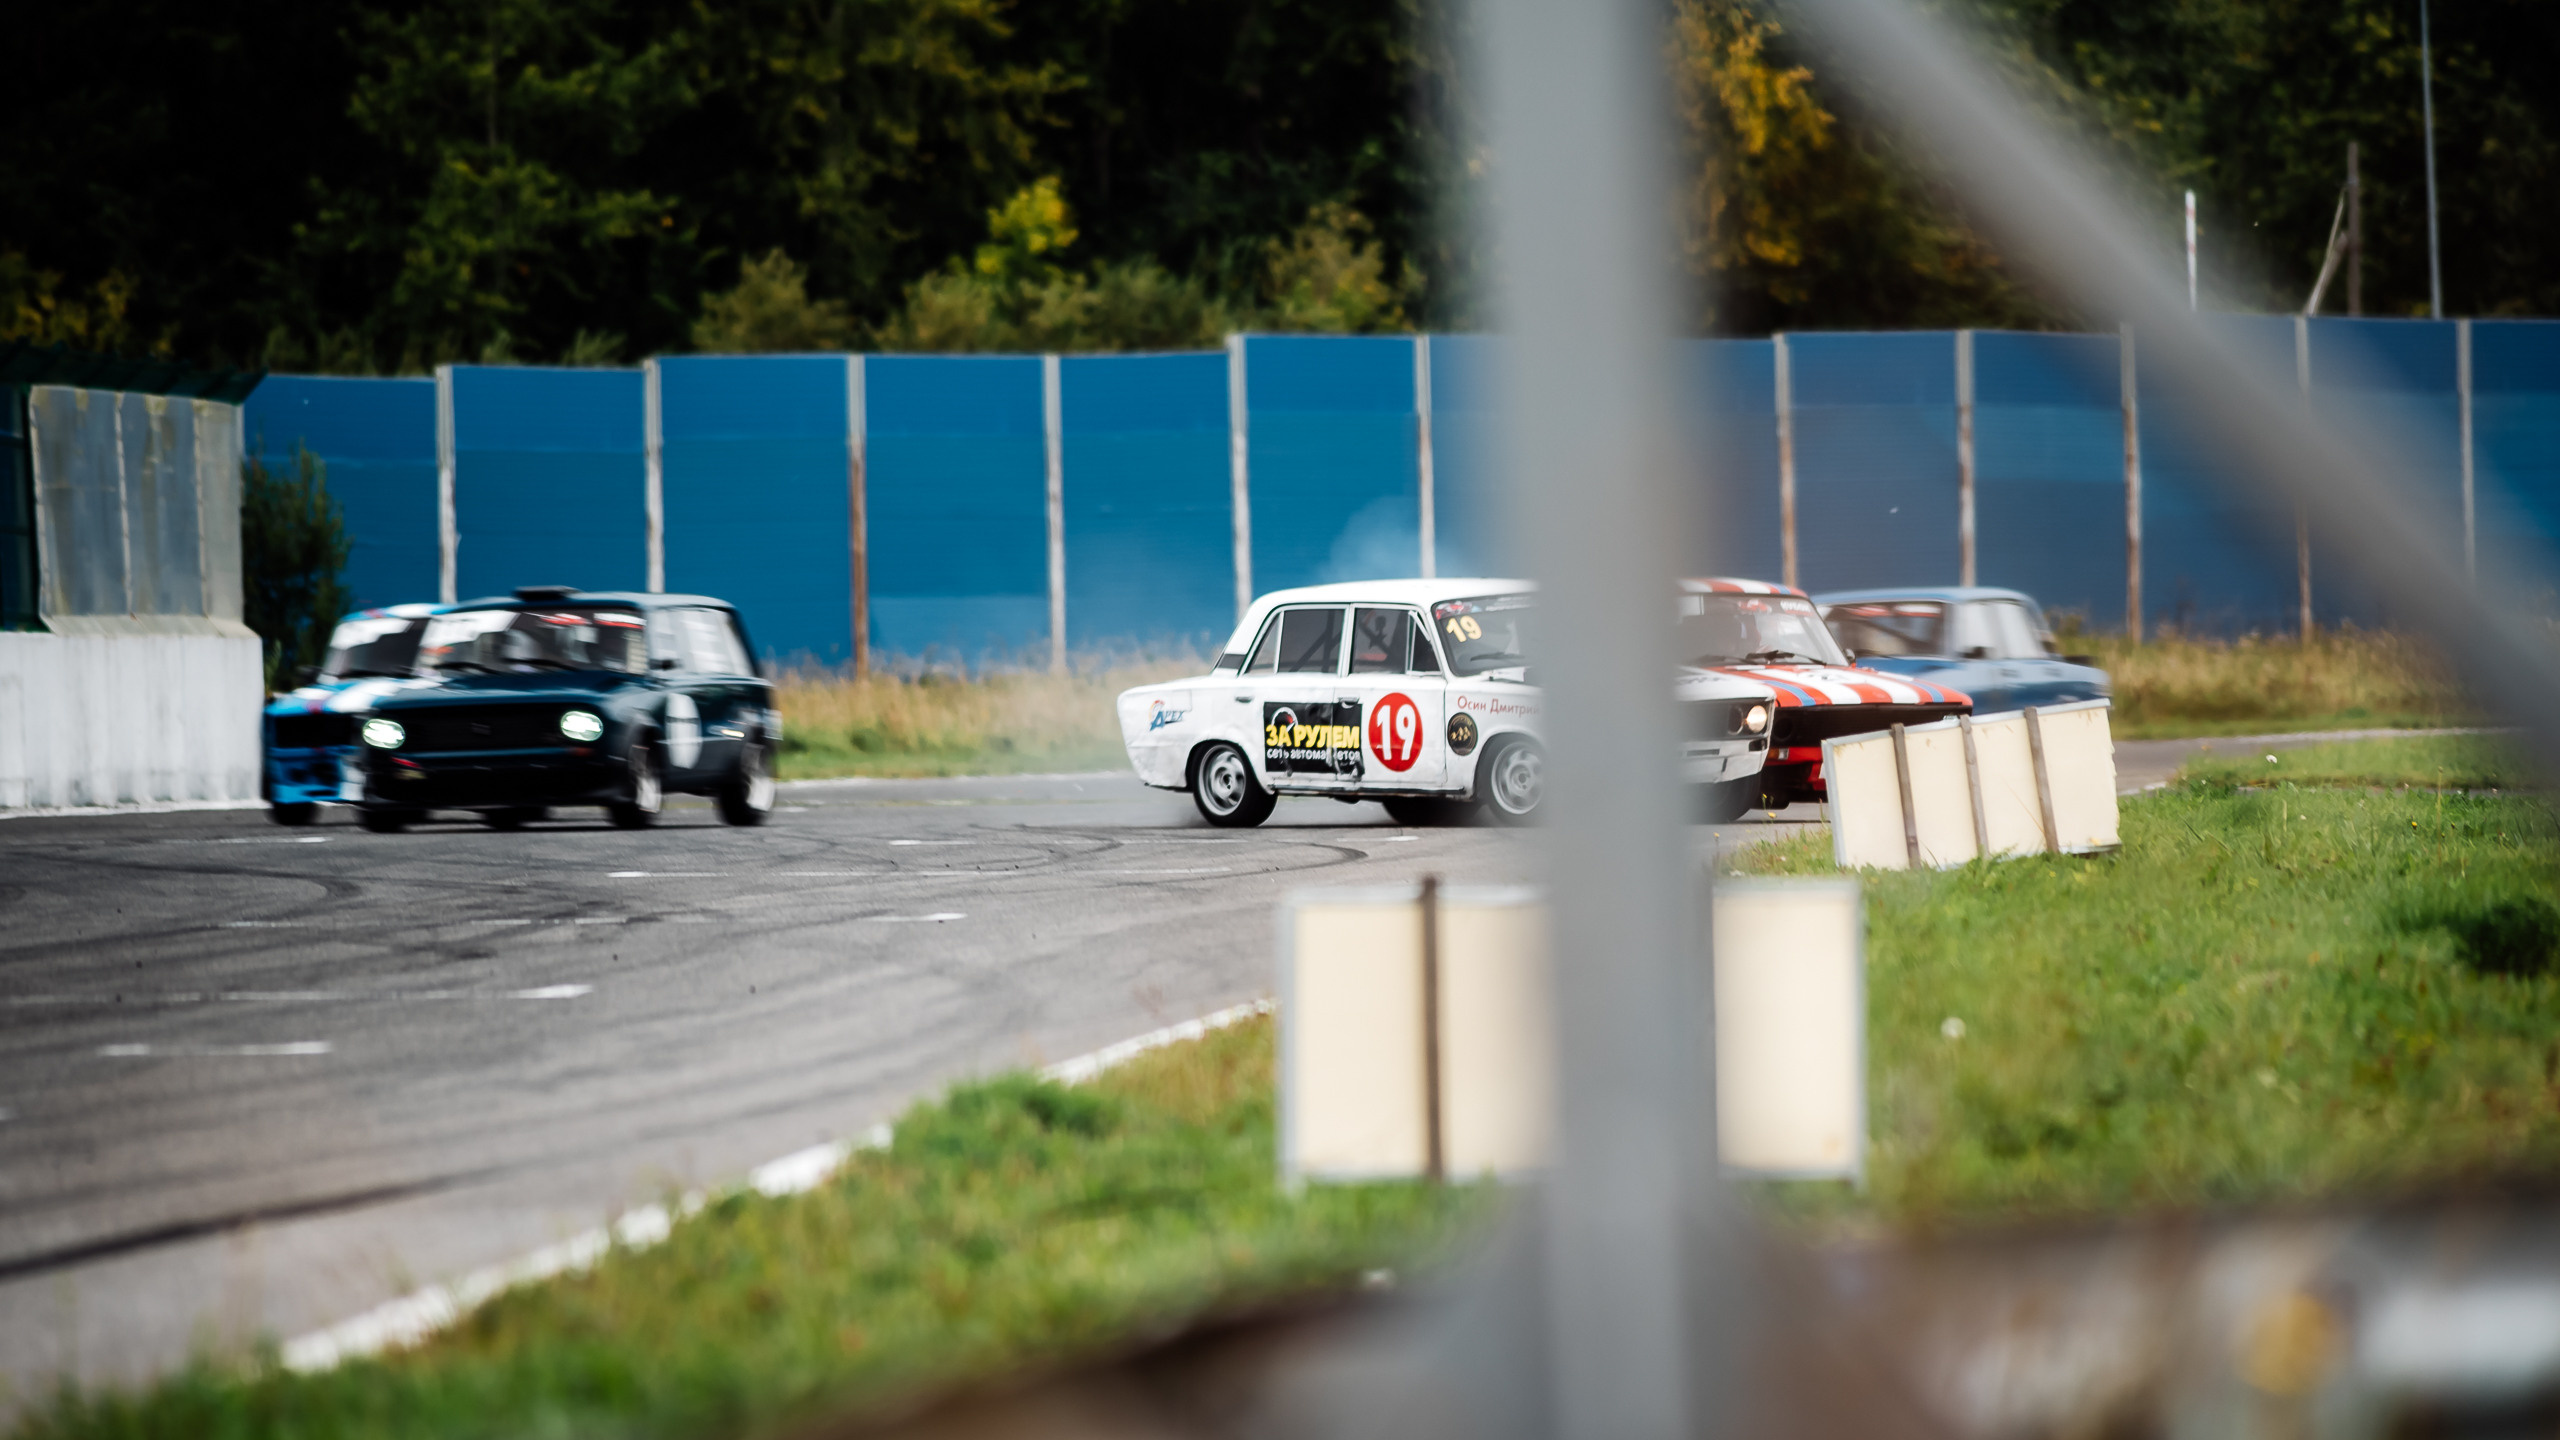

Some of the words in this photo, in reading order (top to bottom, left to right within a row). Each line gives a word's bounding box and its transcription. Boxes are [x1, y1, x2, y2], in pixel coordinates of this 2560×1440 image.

[1446, 615, 1482, 642] 19
[1457, 695, 1487, 711] Осин
[1266, 725, 1292, 747] ЗА
[1293, 725, 1360, 749] РУЛЕМ
[1376, 704, 1416, 761] 19
